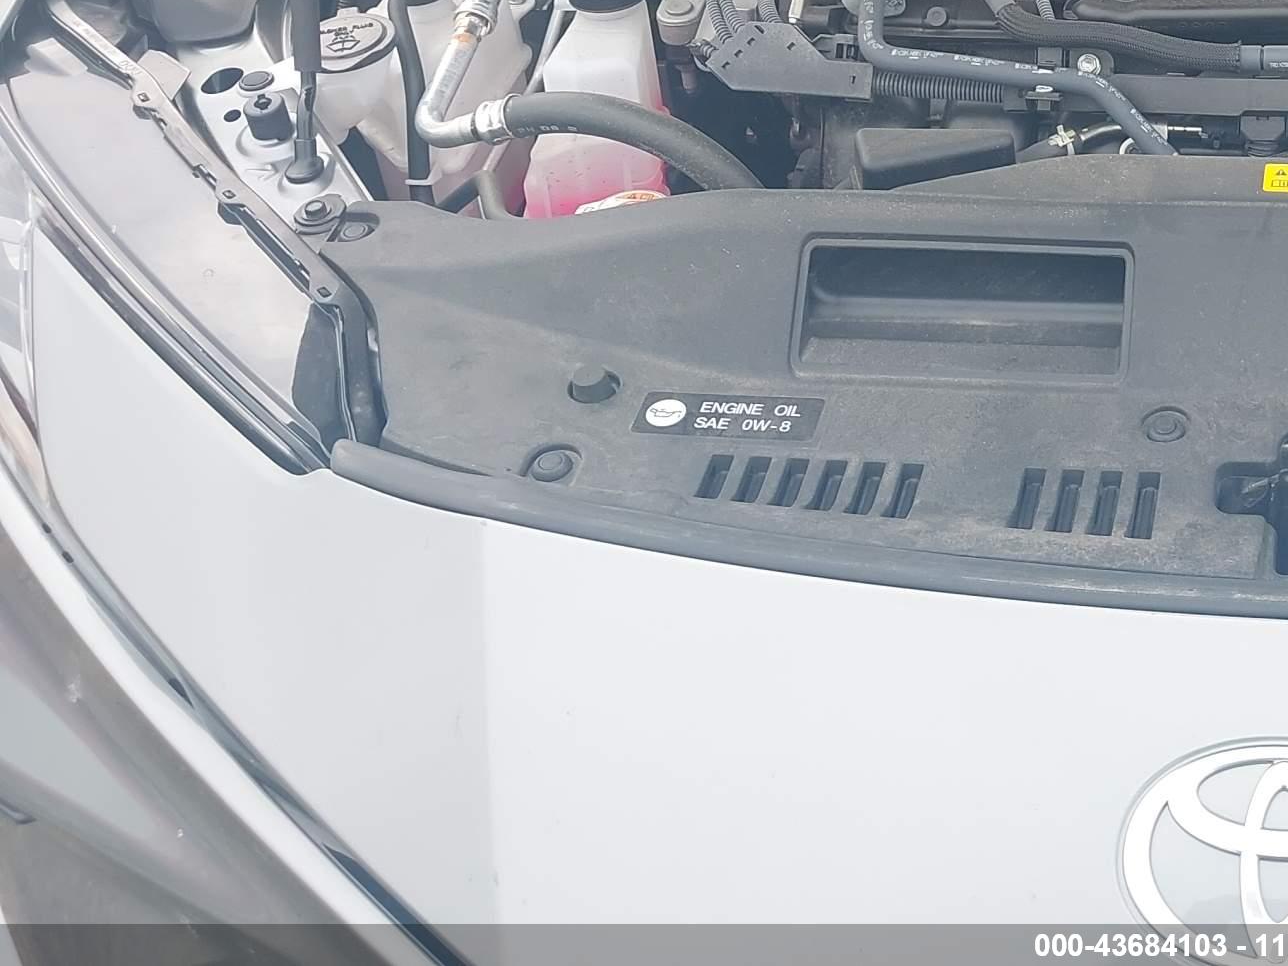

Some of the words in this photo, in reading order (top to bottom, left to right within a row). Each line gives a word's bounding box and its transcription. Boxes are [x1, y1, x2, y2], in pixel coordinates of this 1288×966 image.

[699, 401, 764, 415] ENGINE
[774, 404, 801, 417] OIL
[693, 416, 731, 430] SAE
[742, 419, 792, 432] 0W-8
